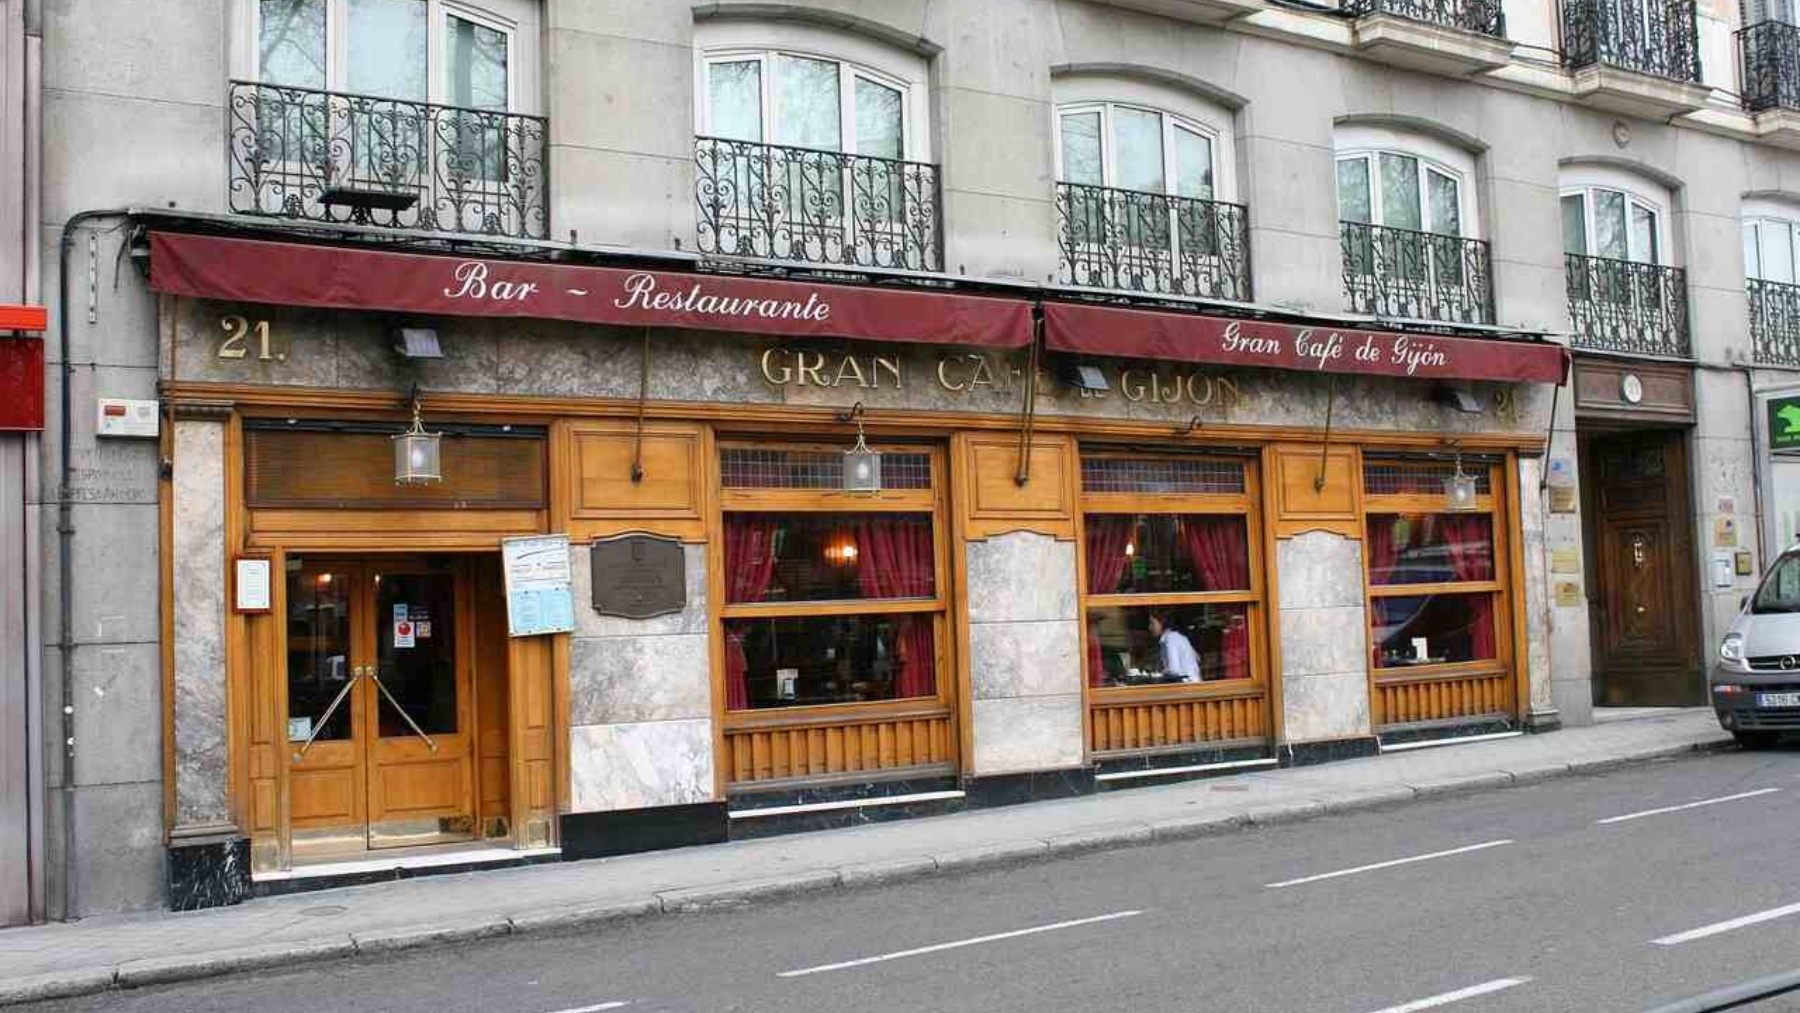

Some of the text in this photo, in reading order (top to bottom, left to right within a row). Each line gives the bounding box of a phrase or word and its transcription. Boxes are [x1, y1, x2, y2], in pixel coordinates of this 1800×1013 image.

[443, 260, 538, 300] Bar
[614, 273, 831, 322] Restaurante
[762, 346, 903, 389] GRAN
[1221, 321, 1446, 375] Gran Café de Gijón
